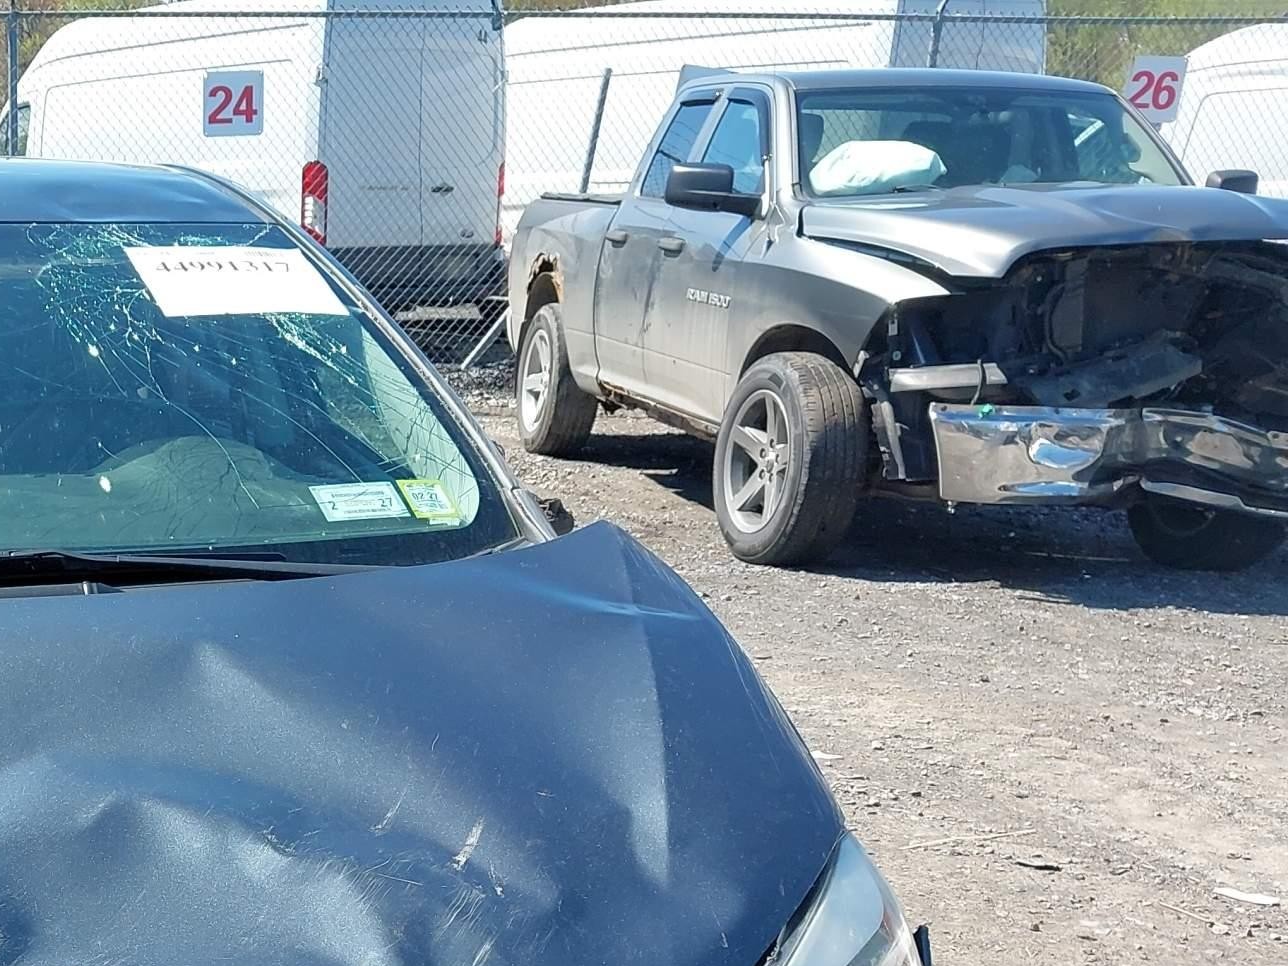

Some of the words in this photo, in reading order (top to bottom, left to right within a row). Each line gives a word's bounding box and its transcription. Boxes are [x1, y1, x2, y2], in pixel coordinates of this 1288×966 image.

[1128, 70, 1179, 111] 26
[208, 85, 258, 125] 24
[156, 260, 290, 273] 44991317
[686, 287, 709, 303] RAM
